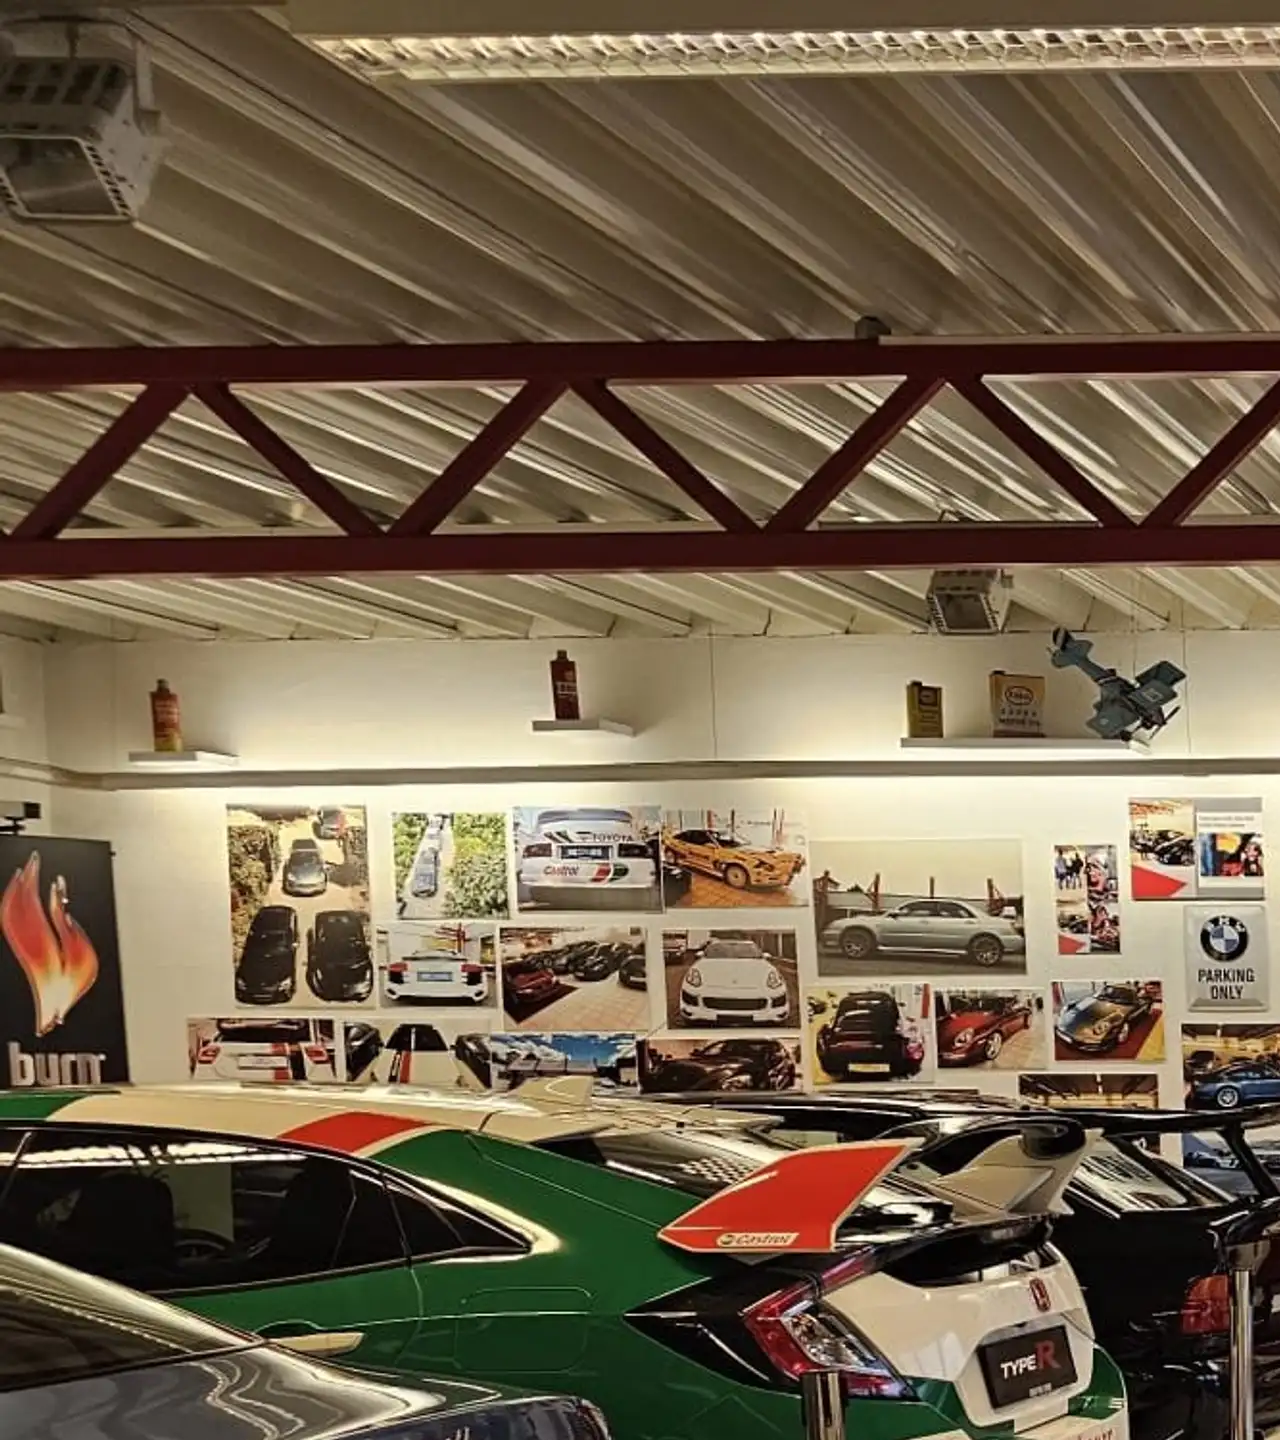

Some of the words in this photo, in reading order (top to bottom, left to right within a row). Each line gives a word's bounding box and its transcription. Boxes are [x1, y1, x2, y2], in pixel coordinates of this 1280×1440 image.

[1198, 967, 1255, 982] PARKING
[1210, 985, 1243, 999] ONLY
[8, 1041, 102, 1086] burn
[1000, 1354, 1037, 1379] TYPE
[1035, 1340, 1061, 1370] R
